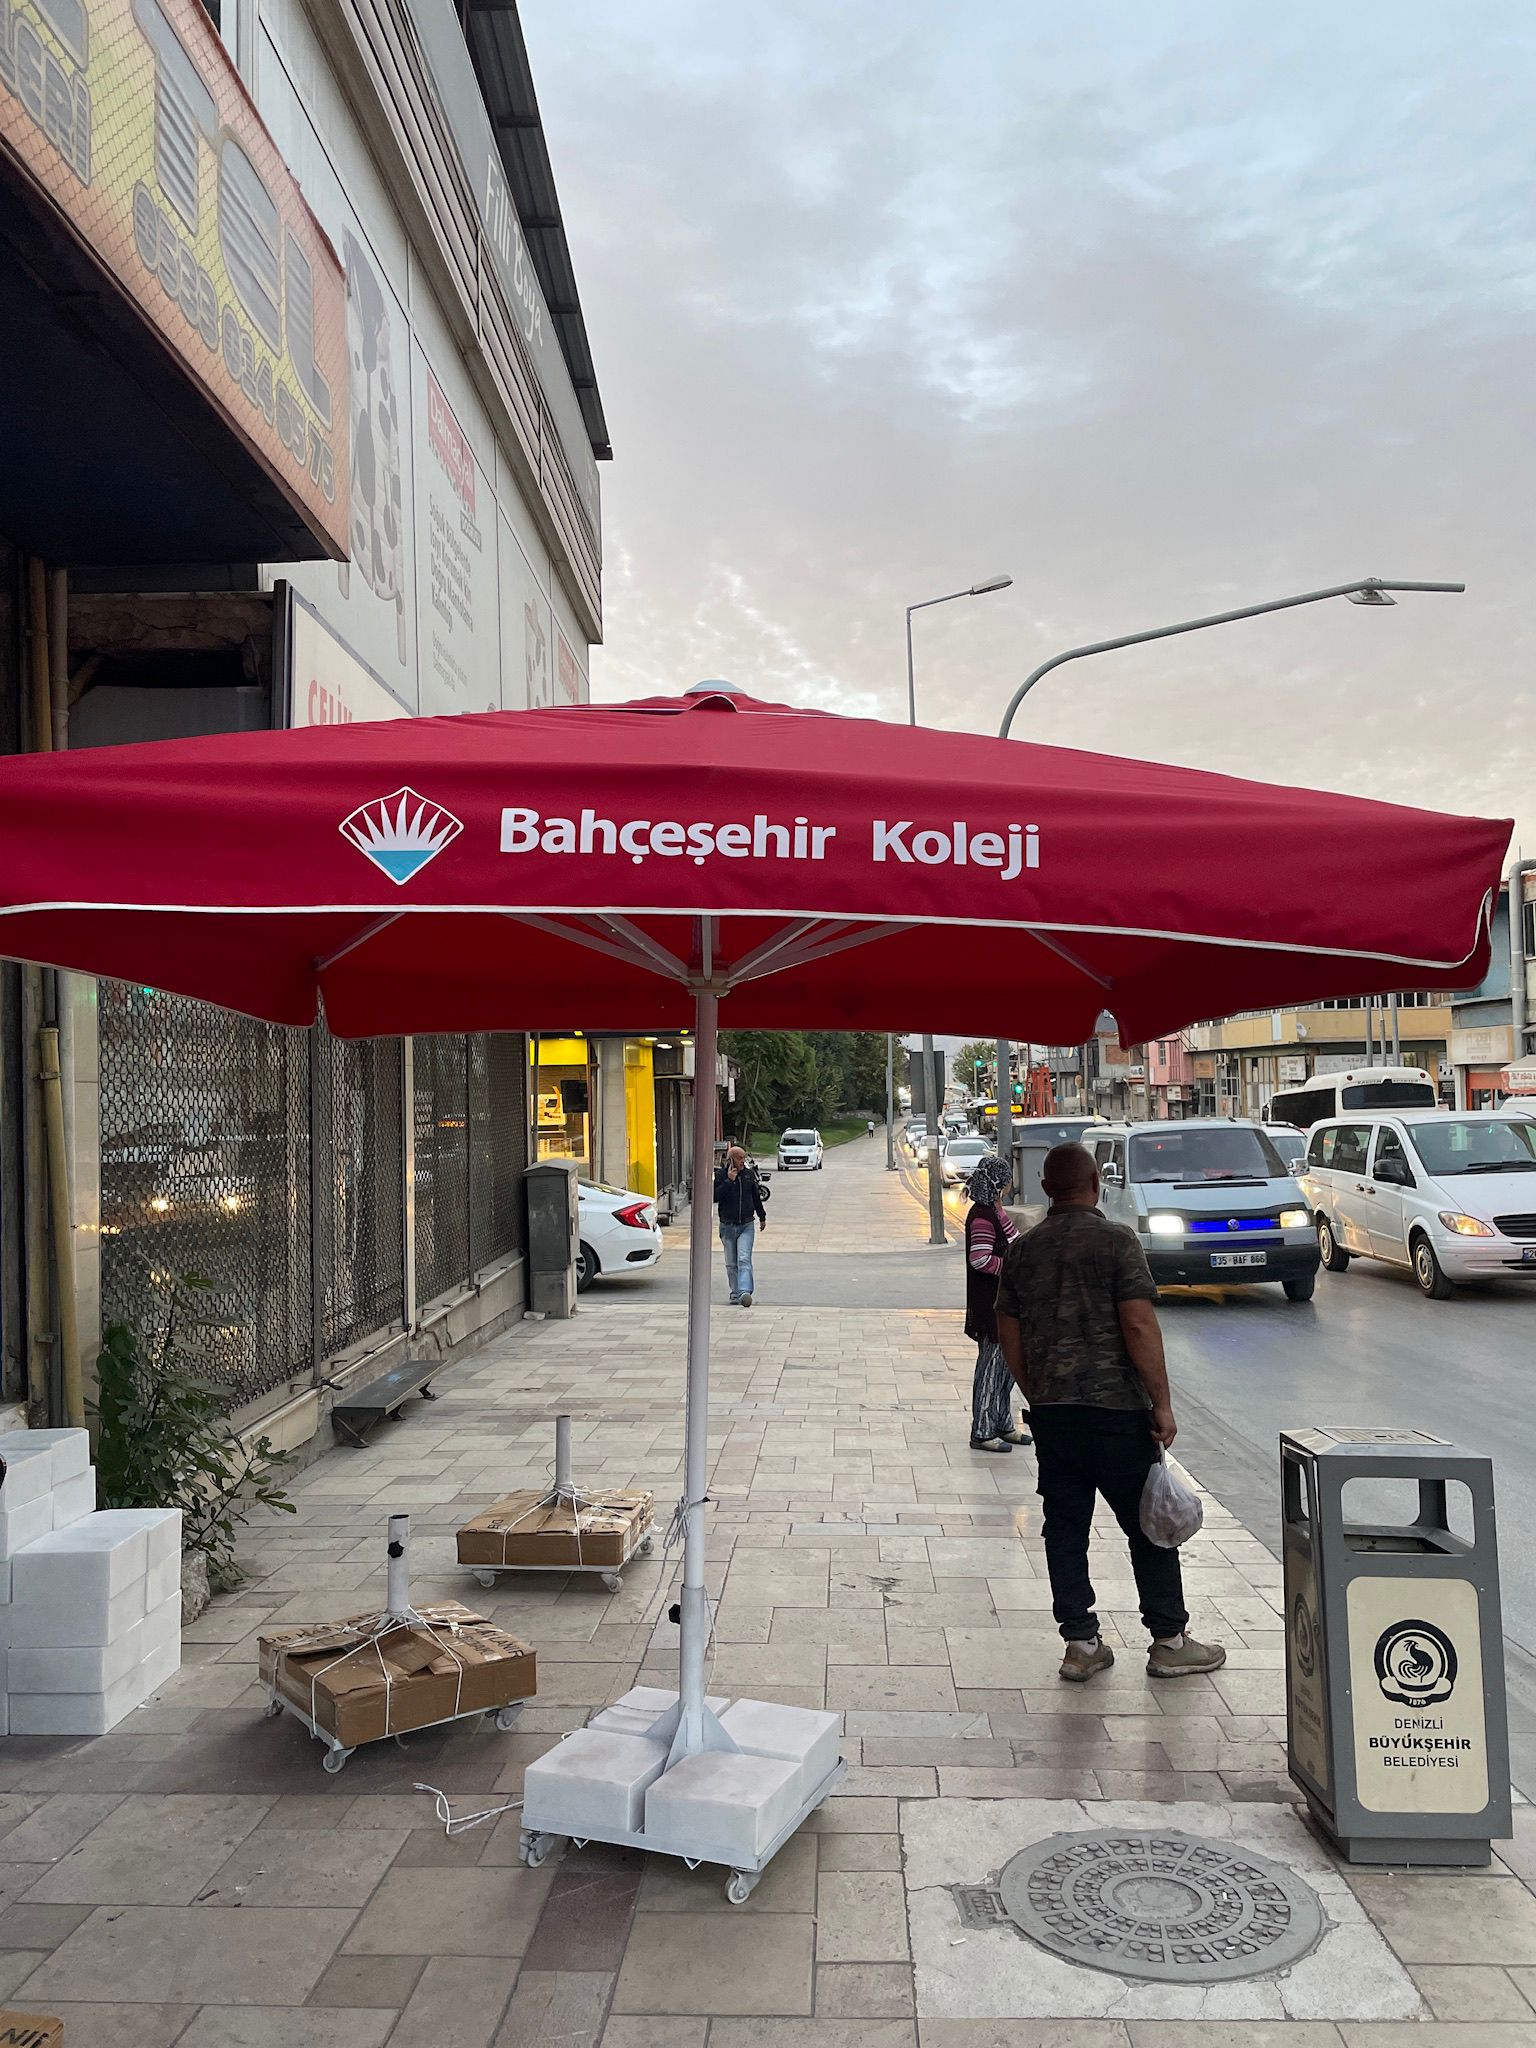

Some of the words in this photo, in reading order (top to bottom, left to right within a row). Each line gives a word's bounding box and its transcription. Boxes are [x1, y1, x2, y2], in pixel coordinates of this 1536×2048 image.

[485, 154, 511, 265] Filli
[512, 220, 544, 347] Boya
[500, 806, 836, 866] Bahçeşehir
[871, 819, 1041, 881] Koleji
[1394, 1716, 1443, 1729] DENİZLİ
[1369, 1735, 1471, 1752] BÜYÜKŞEHİR
[1384, 1755, 1459, 1767] BELEDİYESİ
